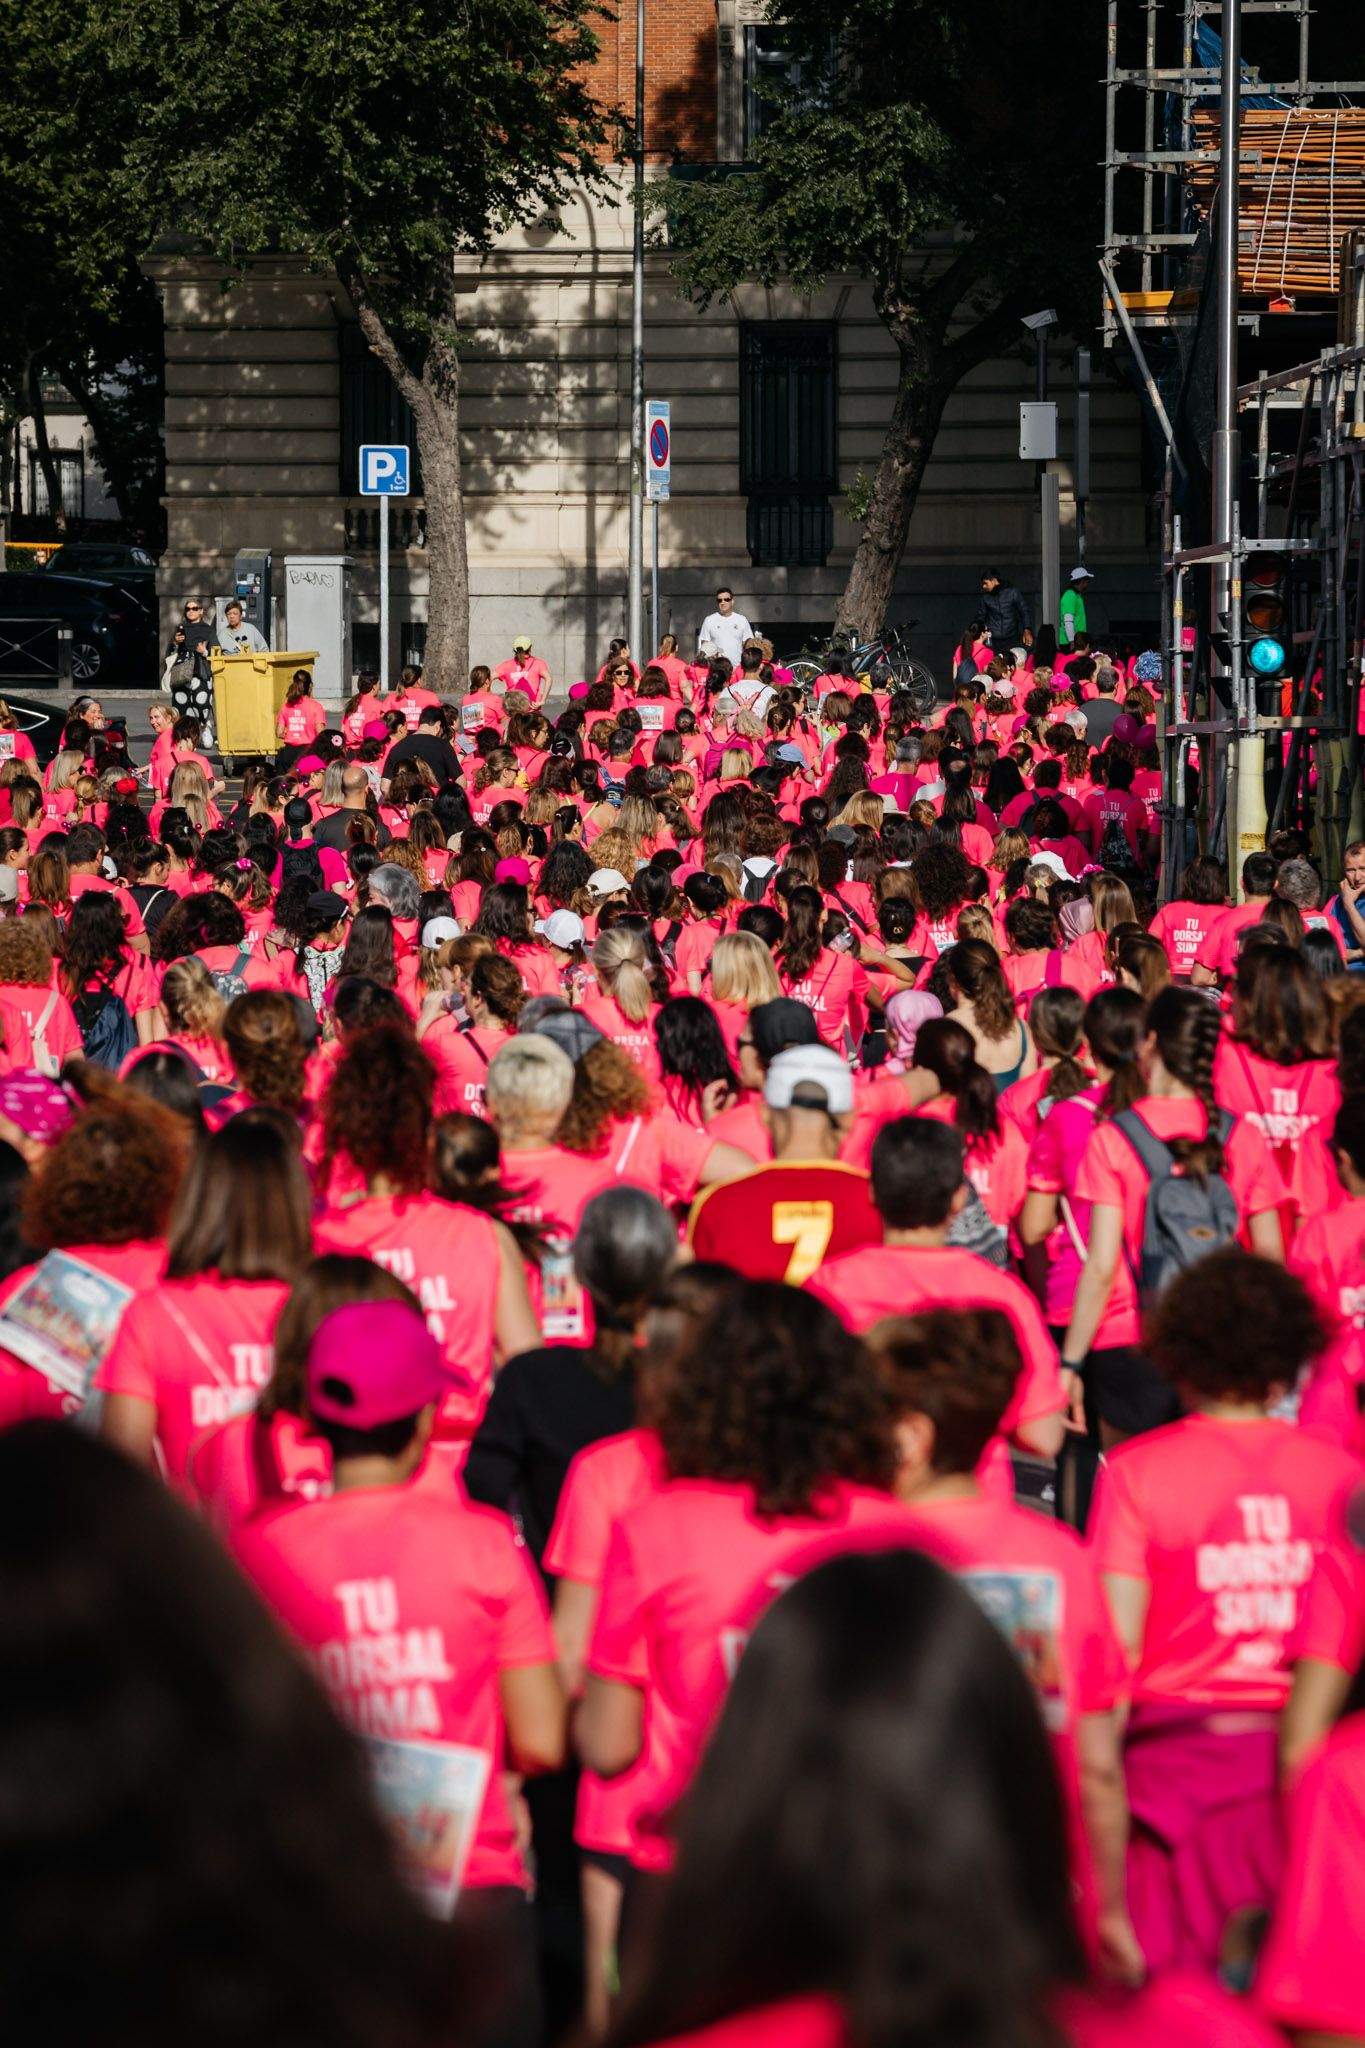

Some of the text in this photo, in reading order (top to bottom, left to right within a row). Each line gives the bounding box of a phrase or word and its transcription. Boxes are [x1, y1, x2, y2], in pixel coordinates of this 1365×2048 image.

[368, 452, 396, 489] P
[1066, 787, 1077, 796] TU
[1148, 788, 1158, 797] TU
[1109, 802, 1120, 811] TU
[1186, 918, 1199, 930] TU
[1176, 941, 1197, 953] SUM
[1271, 1088, 1299, 1114] TU
[772, 1200, 834, 1287] 7
[1237, 1494, 1292, 1543] TU
[334, 1575, 399, 1633] TU
[318, 1626, 456, 1692] ORSAL
